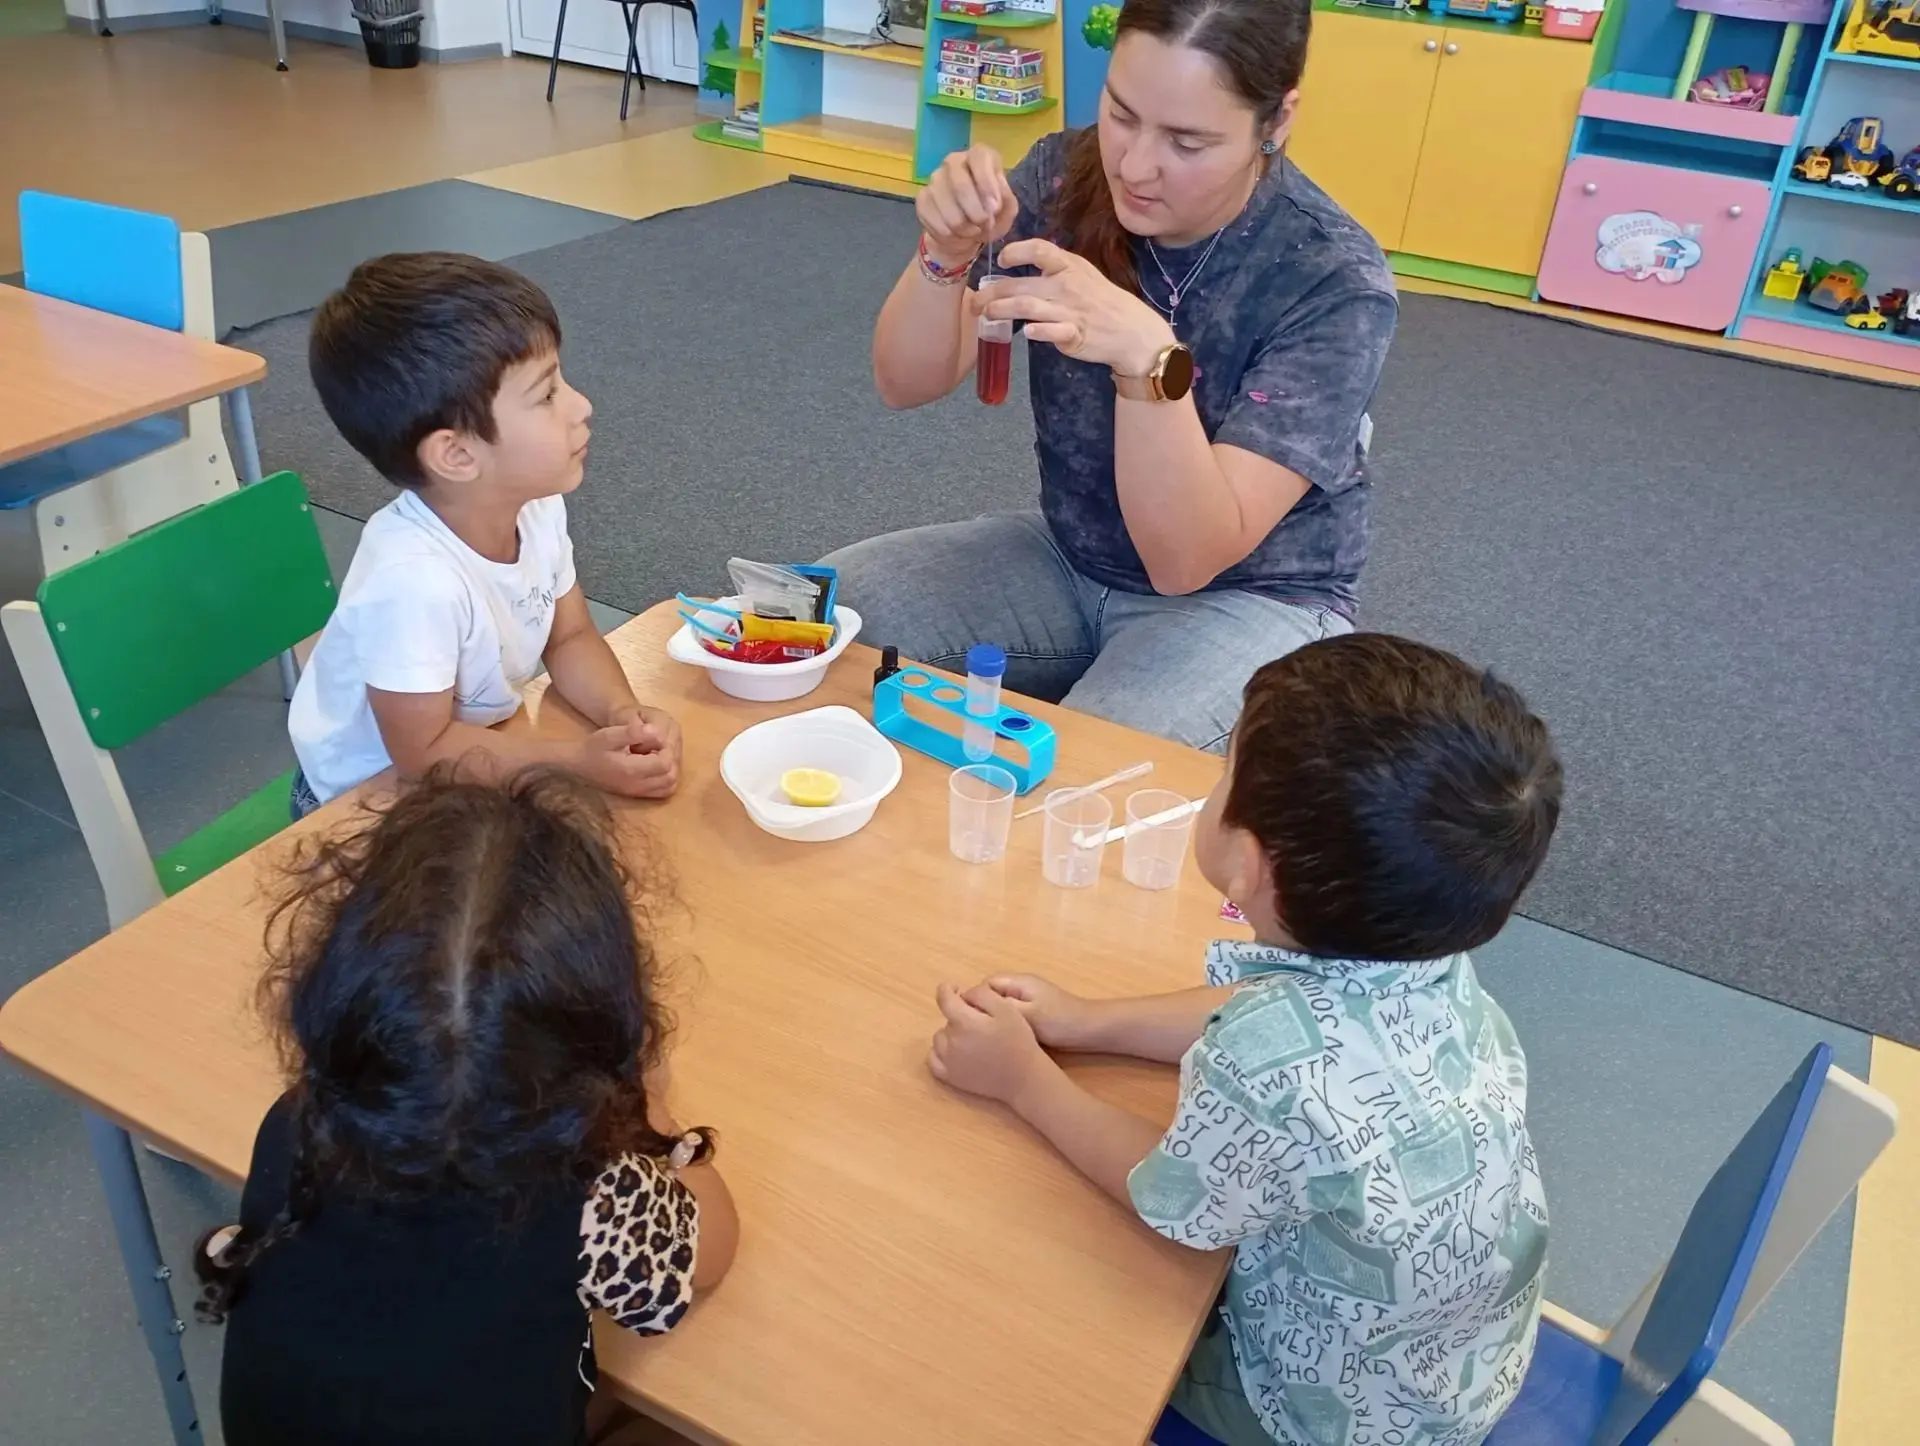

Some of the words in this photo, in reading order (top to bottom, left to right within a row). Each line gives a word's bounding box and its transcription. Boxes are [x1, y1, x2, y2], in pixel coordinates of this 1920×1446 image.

[1254, 1036, 1344, 1099] HATTAN
[1301, 1113, 1384, 1166] TITUDE
[1411, 1200, 1490, 1289] ROCK
[1439, 1271, 1485, 1307] WEST
[1366, 1323, 1398, 1341] AND
[1403, 1330, 1445, 1364] TRADE
[1411, 1339, 1449, 1382] MARK
[1370, 1389, 1425, 1446] OCK
